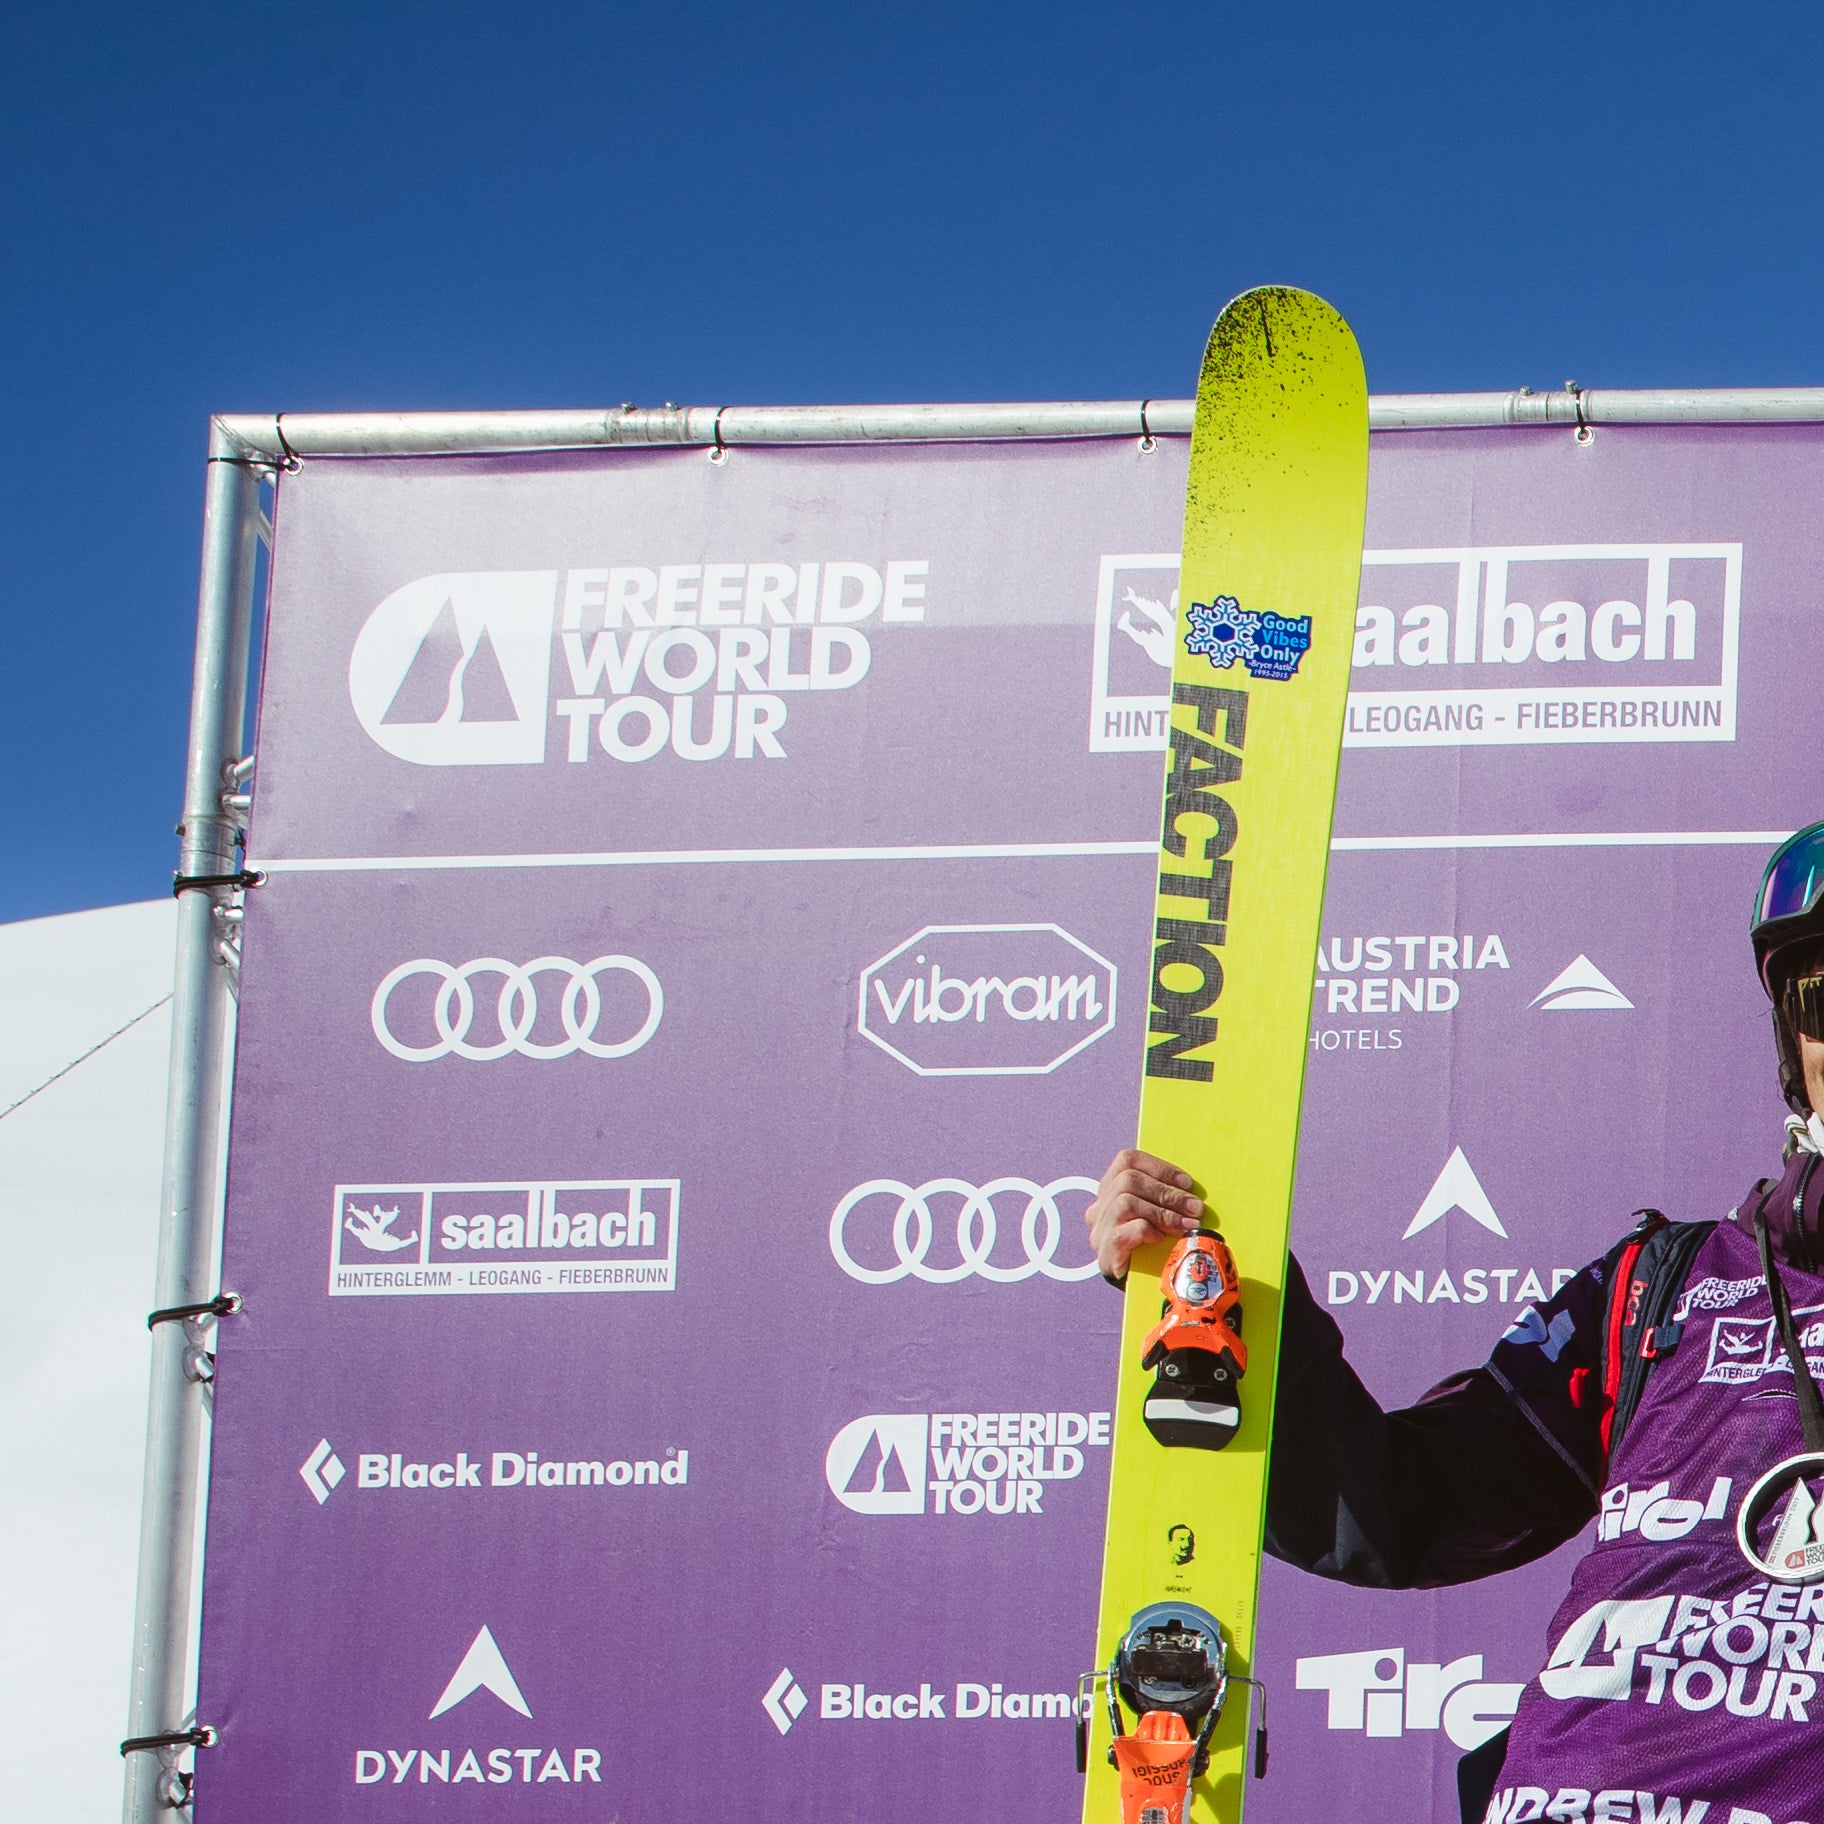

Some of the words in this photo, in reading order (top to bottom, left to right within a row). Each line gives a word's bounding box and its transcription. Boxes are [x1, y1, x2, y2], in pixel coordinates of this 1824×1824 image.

[565, 561, 928, 625] FREERIDE
[1262, 629, 1309, 649] Vibes
[1263, 614, 1309, 634] Good
[561, 627, 871, 695] WORLD
[1260, 644, 1301, 667] Only
[557, 694, 787, 762] TOUR
[1349, 703, 1483, 734] LEOGANG
[1516, 700, 1722, 730] FIEBERBRUNN
[1145, 683, 1249, 1083] FACTION
[873, 954, 1105, 1024] vibram
[441, 1188, 656, 1251] saalbach
[336, 1270, 453, 1289] HINTERGLEMM
[468, 1268, 542, 1286] LEOGANG
[559, 1267, 669, 1285] FIEBERBRUNN
[931, 1413, 1110, 1446] FREERIDE
[359, 1453, 481, 1488] Black
[492, 1449, 688, 1486] Diamond
[932, 1446, 1084, 1481] WORLD
[929, 1480, 1043, 1514] TOUR
[821, 1684, 945, 1719] Black
[1640, 1653, 1816, 1722] TOUR
[356, 1748, 601, 1783] DYNASTAR
